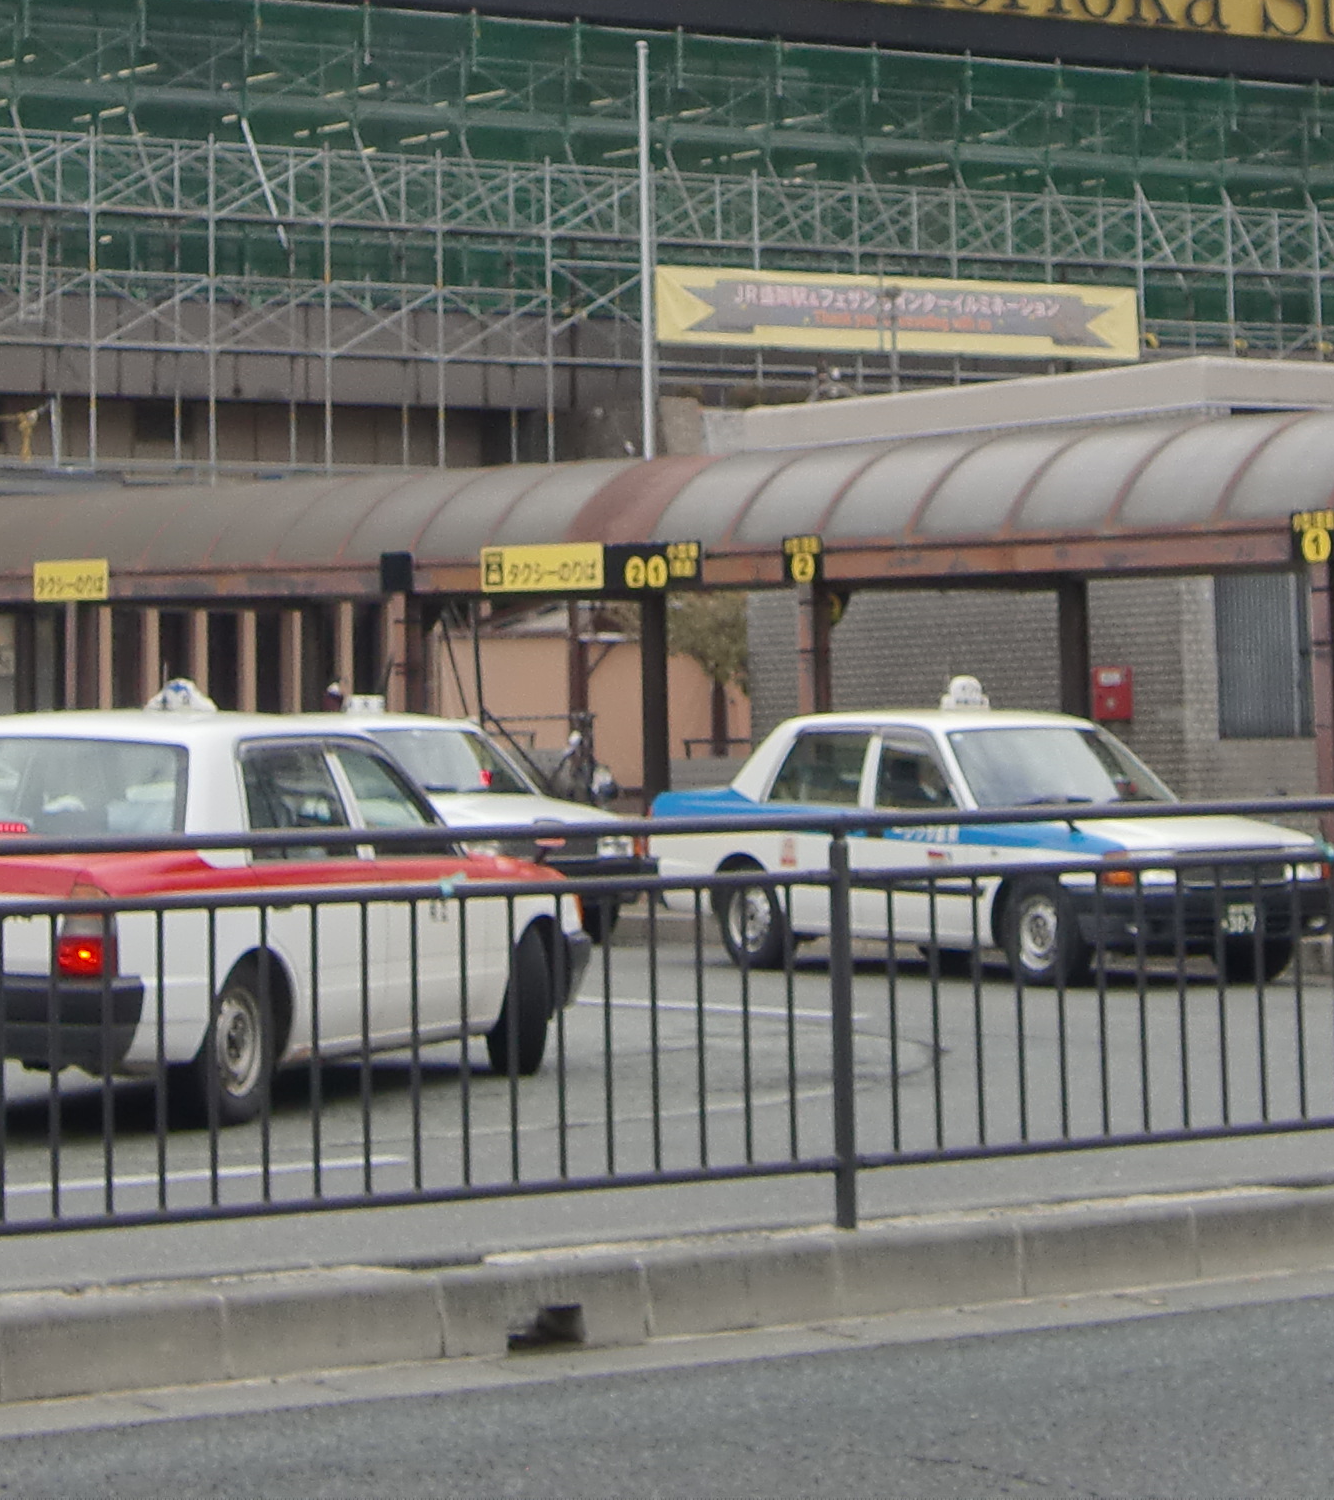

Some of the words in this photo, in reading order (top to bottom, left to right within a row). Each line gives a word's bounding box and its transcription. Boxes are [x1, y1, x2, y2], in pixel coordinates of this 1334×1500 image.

[508, 558, 597, 584] タクシーのりば
[37, 573, 105, 596] タクシーのりば
